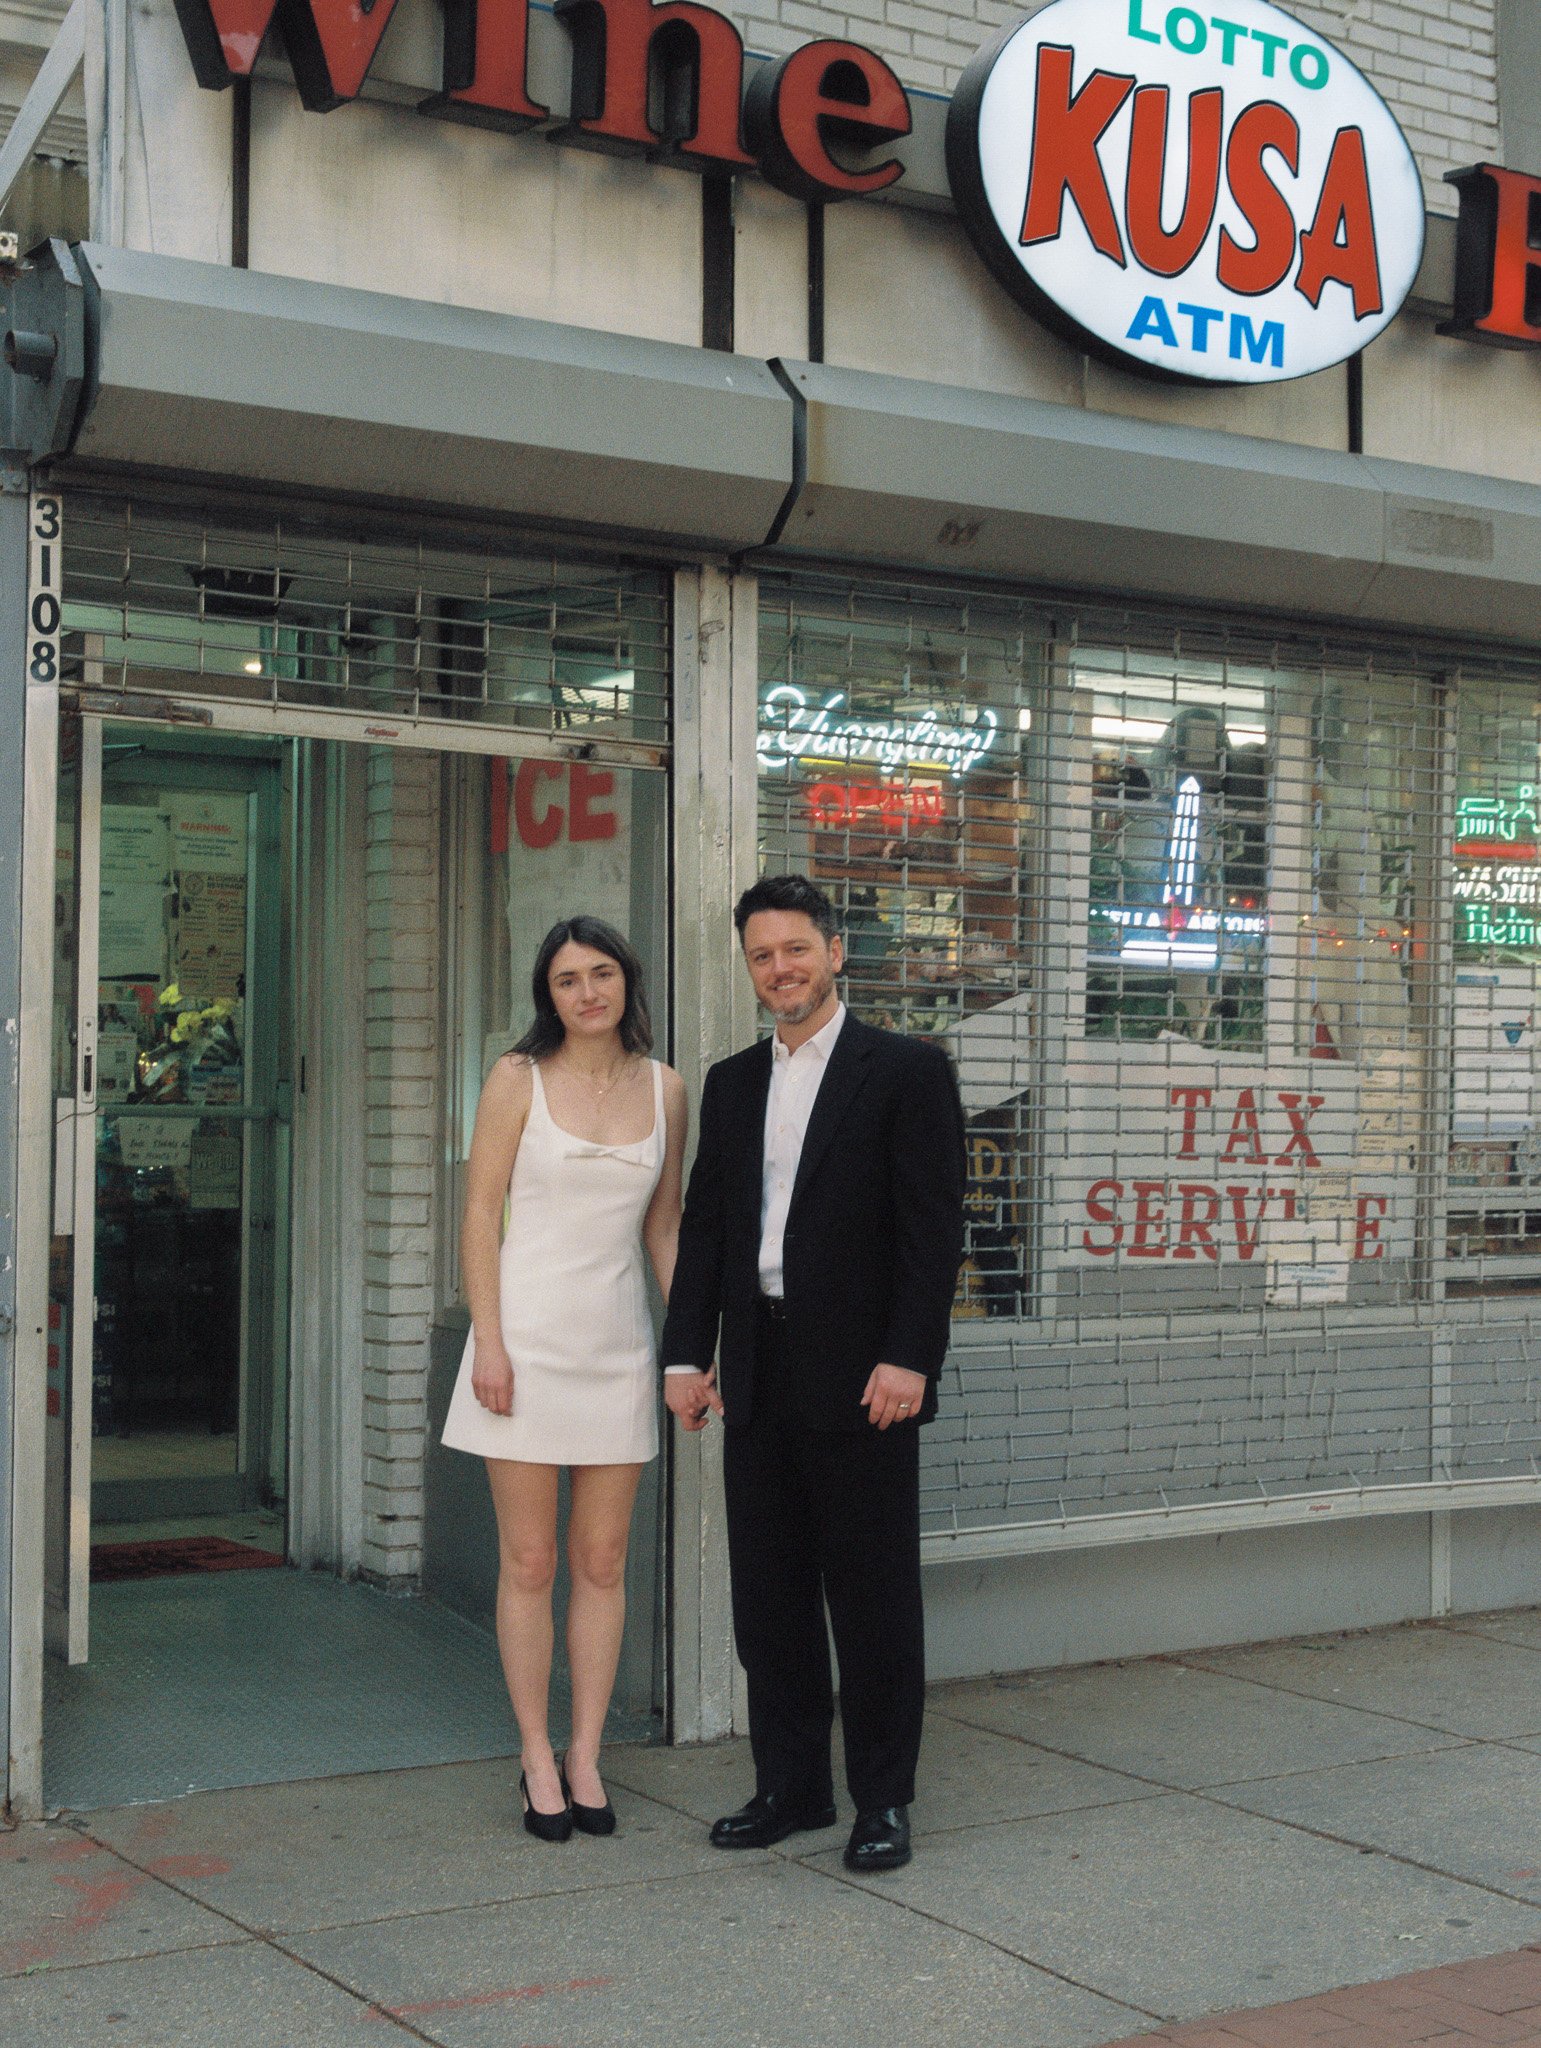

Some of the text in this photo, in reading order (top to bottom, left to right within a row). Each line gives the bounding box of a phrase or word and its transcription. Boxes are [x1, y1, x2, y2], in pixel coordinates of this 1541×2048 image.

[1127, 0, 1331, 91] LOTTO
[1018, 42, 1384, 322] KUSA
[1125, 295, 1285, 368] ATM
[30, 498, 60, 684] 3108
[490, 755, 618, 853] ICE
[1171, 1088, 1325, 1167] TAX
[1083, 1181, 1387, 1260] SERVE
